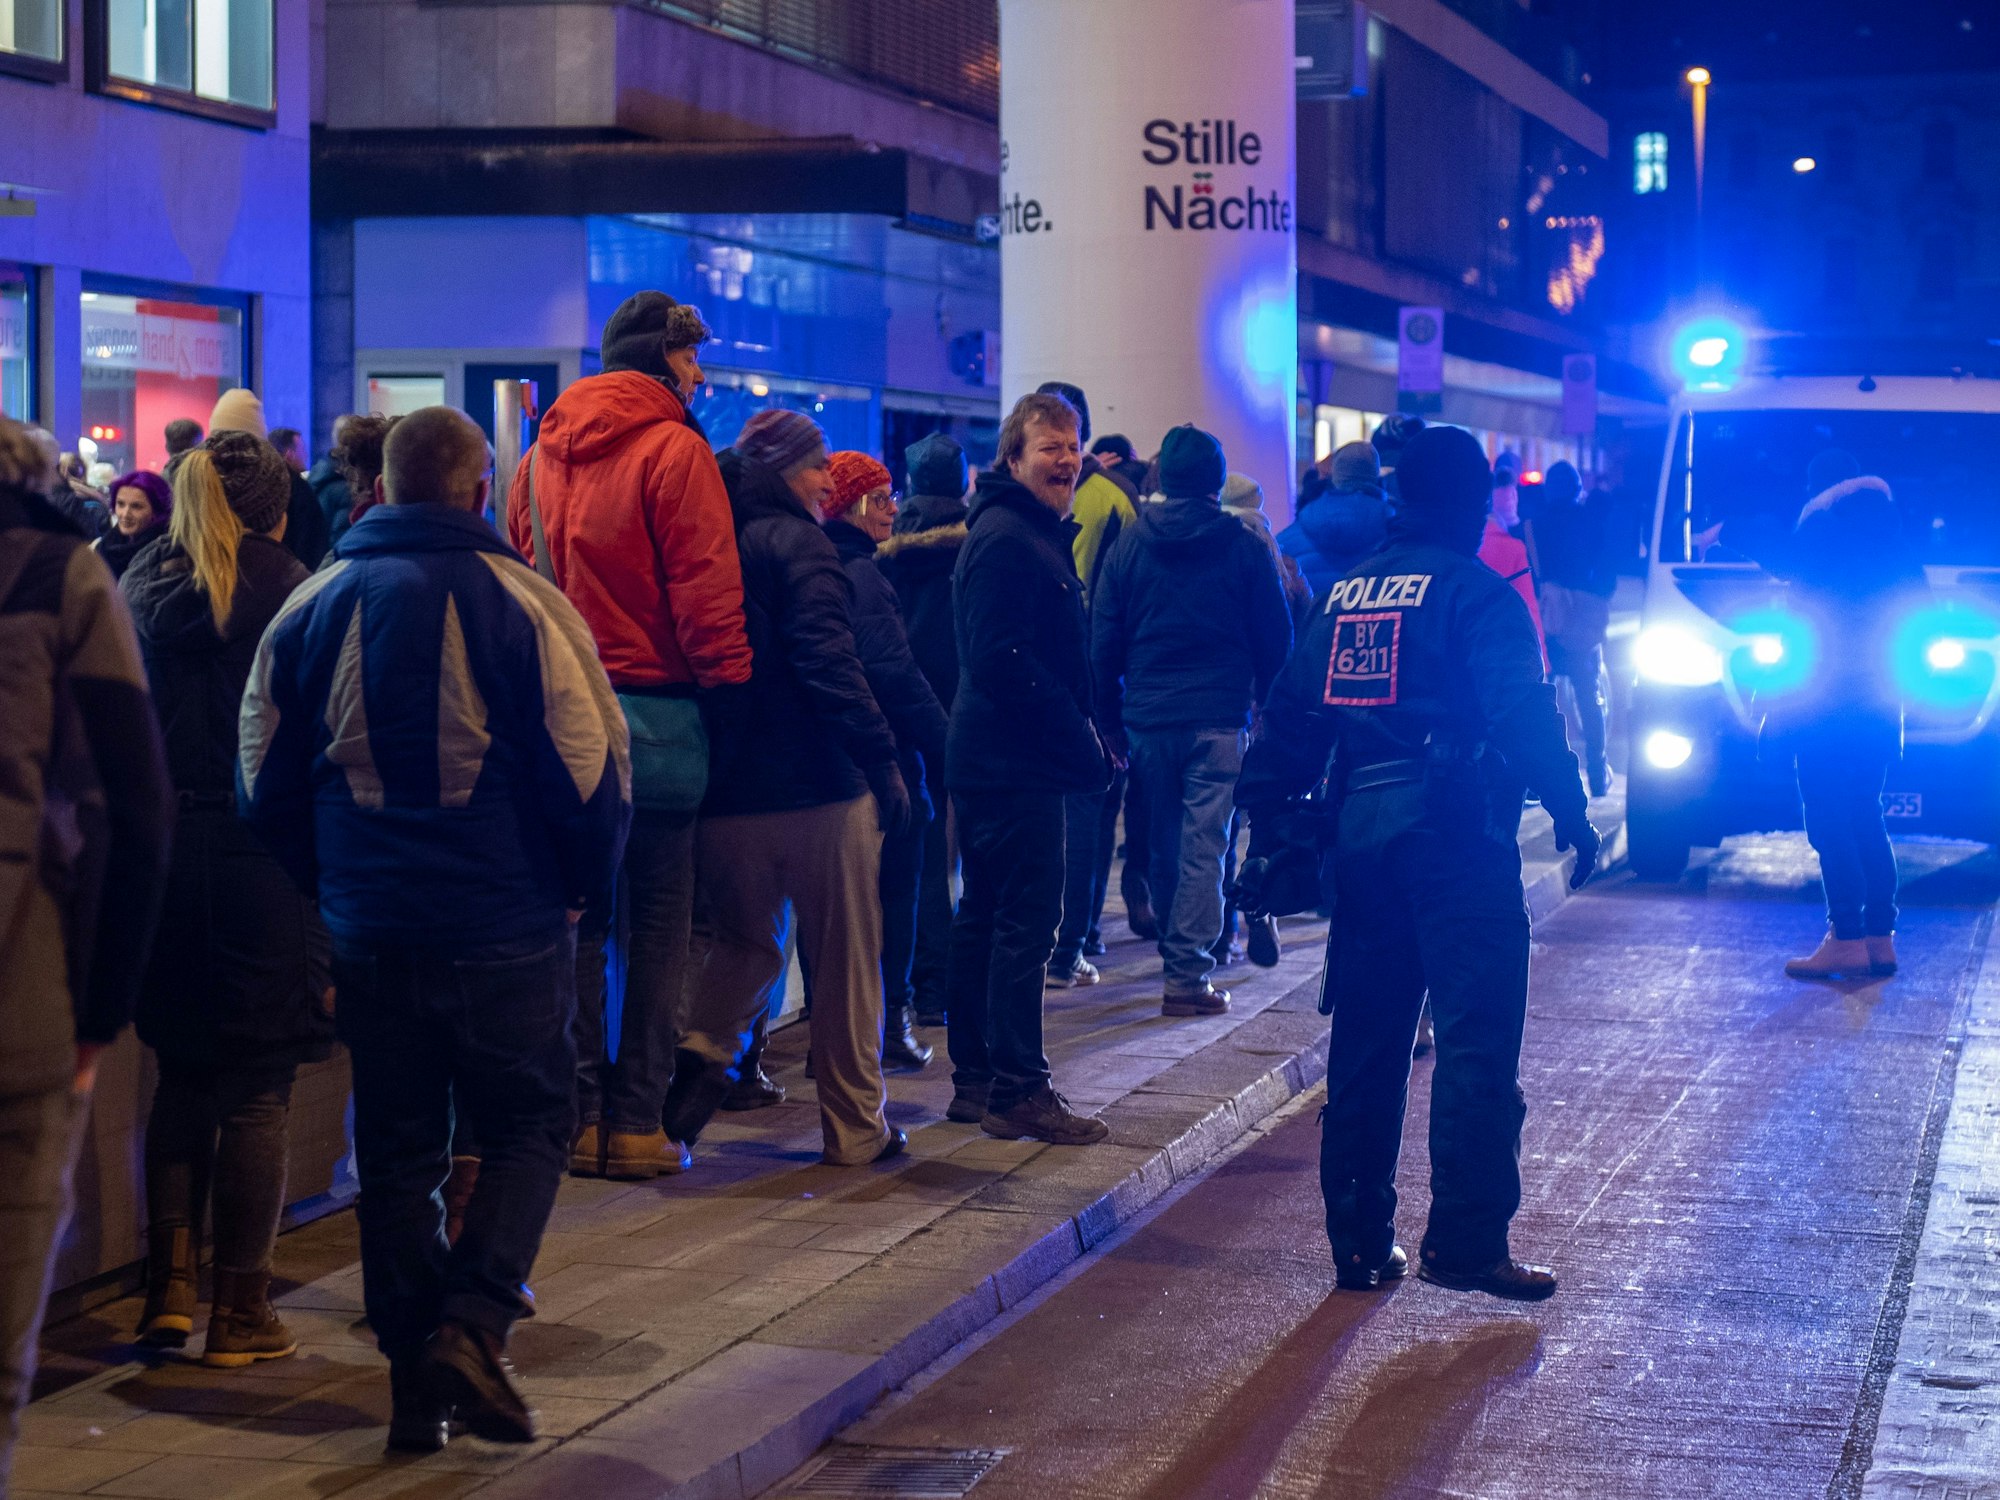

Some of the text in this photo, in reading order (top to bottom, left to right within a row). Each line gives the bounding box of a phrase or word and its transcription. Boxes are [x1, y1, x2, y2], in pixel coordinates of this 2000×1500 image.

[1142, 119, 1261, 165] Stille
[142, 317, 175, 363] hand
[1324, 574, 1433, 615] POLIZEI
[1355, 622, 1380, 648] BY
[1337, 647, 1388, 674] 6211
[1882, 795, 1918, 815] 955
